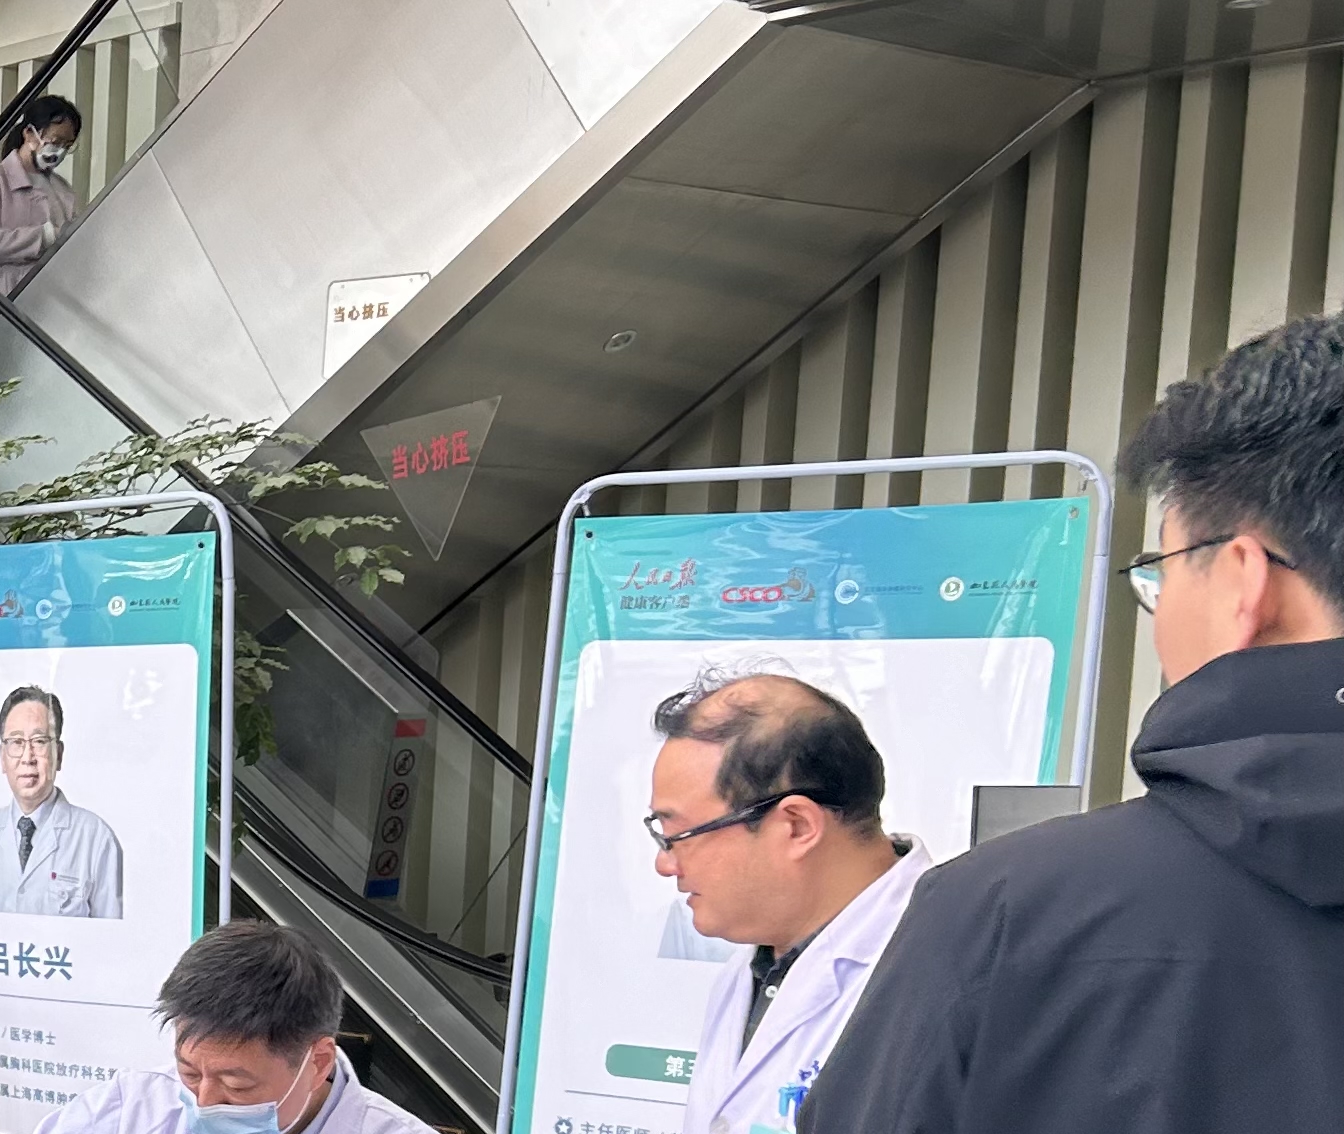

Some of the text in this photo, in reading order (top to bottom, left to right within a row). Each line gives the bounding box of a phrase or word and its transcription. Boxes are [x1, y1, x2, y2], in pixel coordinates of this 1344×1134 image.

[333, 301, 390, 323] 当心挤压
[391, 429, 471, 479] 当心挤压
[620, 595, 690, 610] 健康客户端
[722, 586, 783, 604] CSCO
